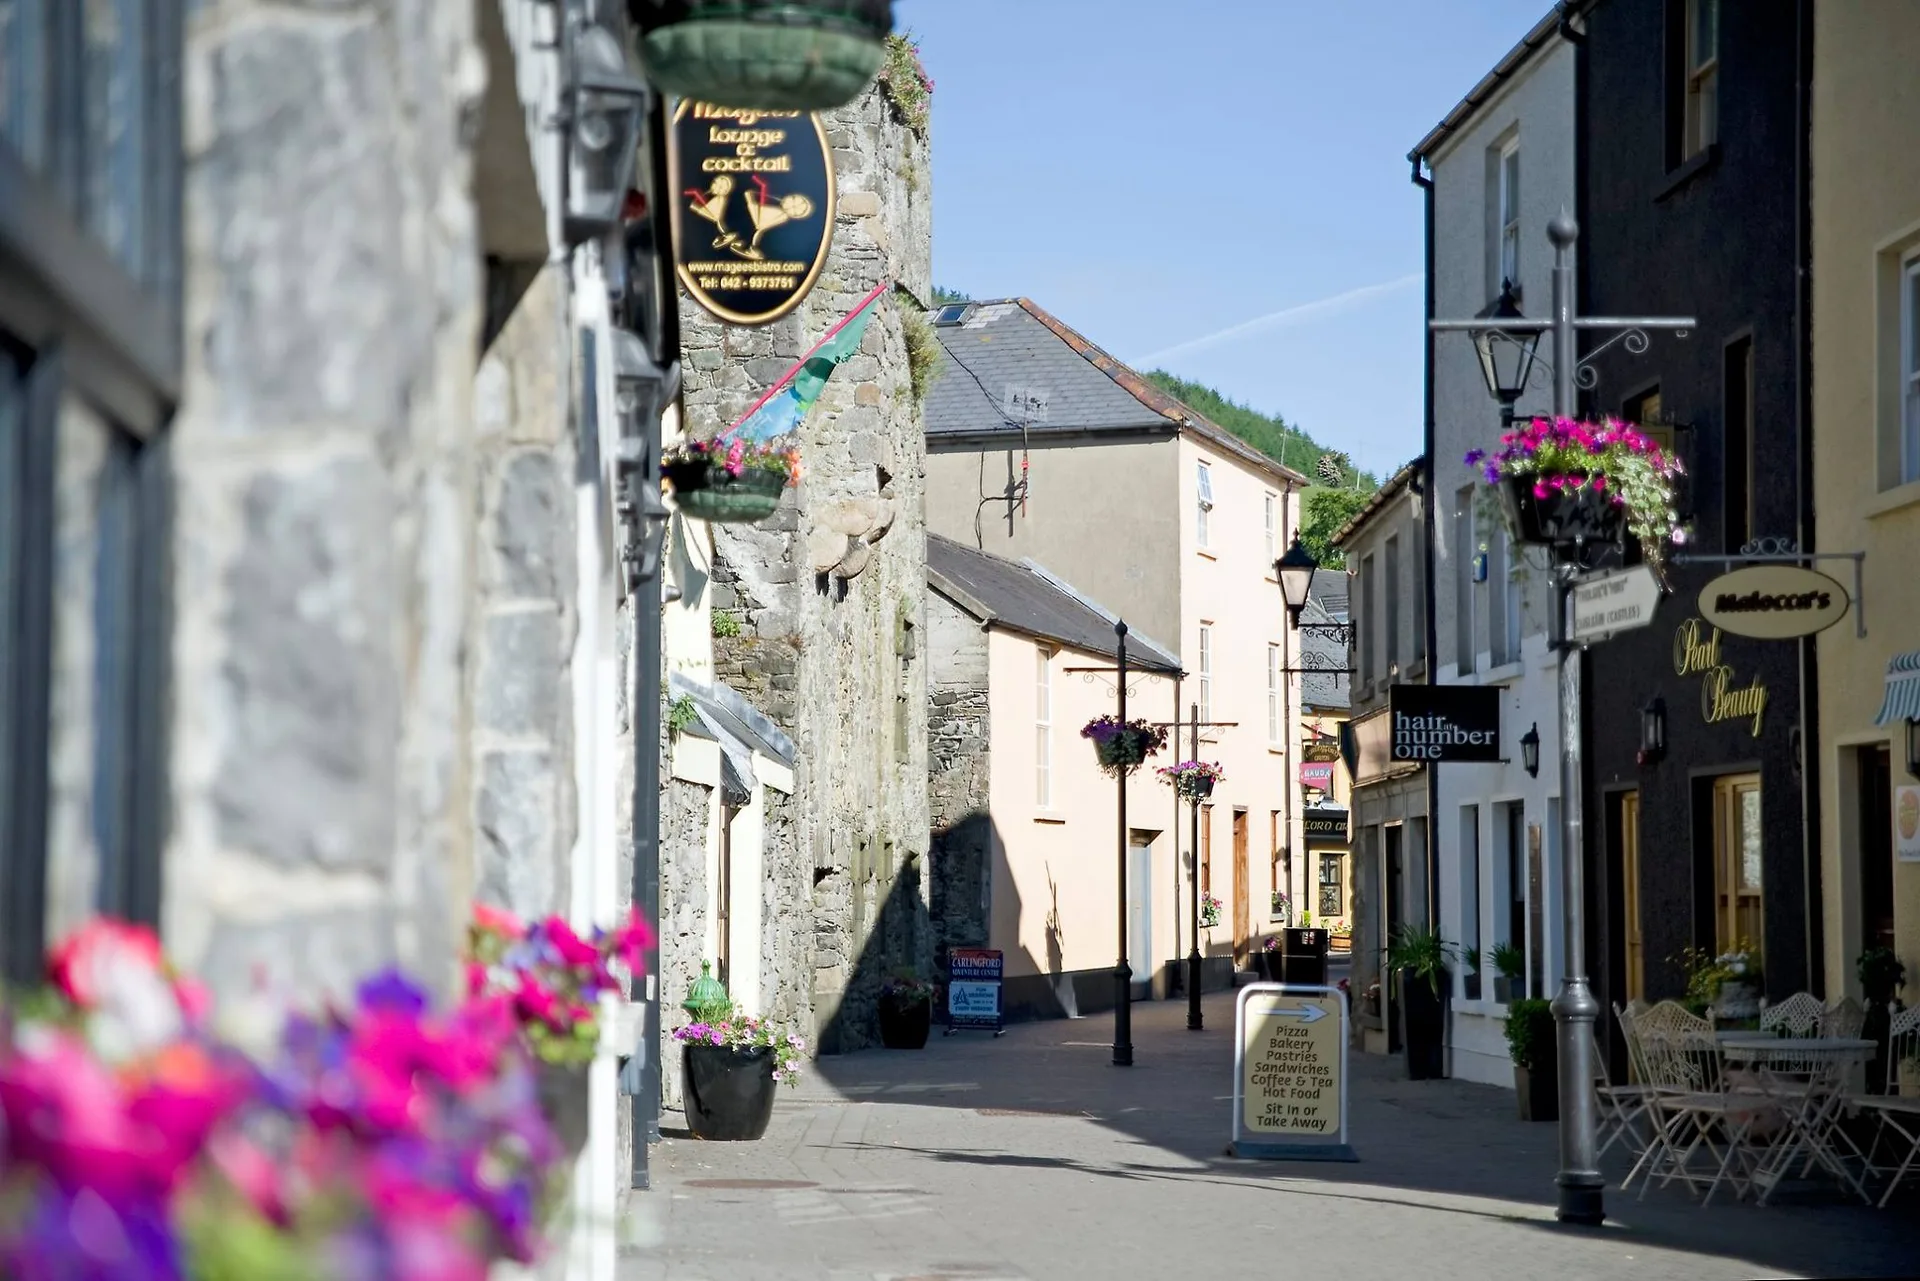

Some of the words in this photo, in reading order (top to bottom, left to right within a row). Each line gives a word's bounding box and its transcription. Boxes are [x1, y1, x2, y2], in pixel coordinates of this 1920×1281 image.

[709, 126, 783, 146] lounge
[702, 154, 790, 171] cocktail
[688, 262, 804, 274] www.mageesbistro.com
[699, 277, 718, 288] Tel:
[720, 277, 741, 288] 042
[1673, 617, 1721, 676] Pearl
[1701, 664, 1769, 738] Beauty
[1395, 710, 1447, 730] hair
[1395, 725, 1495, 745] number
[1395, 743, 1442, 759] one
[951, 957, 1001, 968] CARLINGFORD
[1276, 1025, 1309, 1037] Pizza
[1269, 1038, 1315, 1052] Bakery
[1266, 1050, 1318, 1062] Pastries
[1254, 1062, 1329, 1075] Sandwiches
[1250, 1074, 1291, 1088] Coffee
[1295, 1076, 1307, 1087] &
[1310, 1076, 1333, 1088] Tea
[1262, 1087, 1286, 1098] Hot
[1290, 1088, 1320, 1099] Food
[1265, 1103, 1283, 1114] Sit
[1287, 1104, 1299, 1115] In
[1304, 1107, 1318, 1115] or
[1256, 1116, 1287, 1127] Take
[1291, 1117, 1327, 1131] Away
